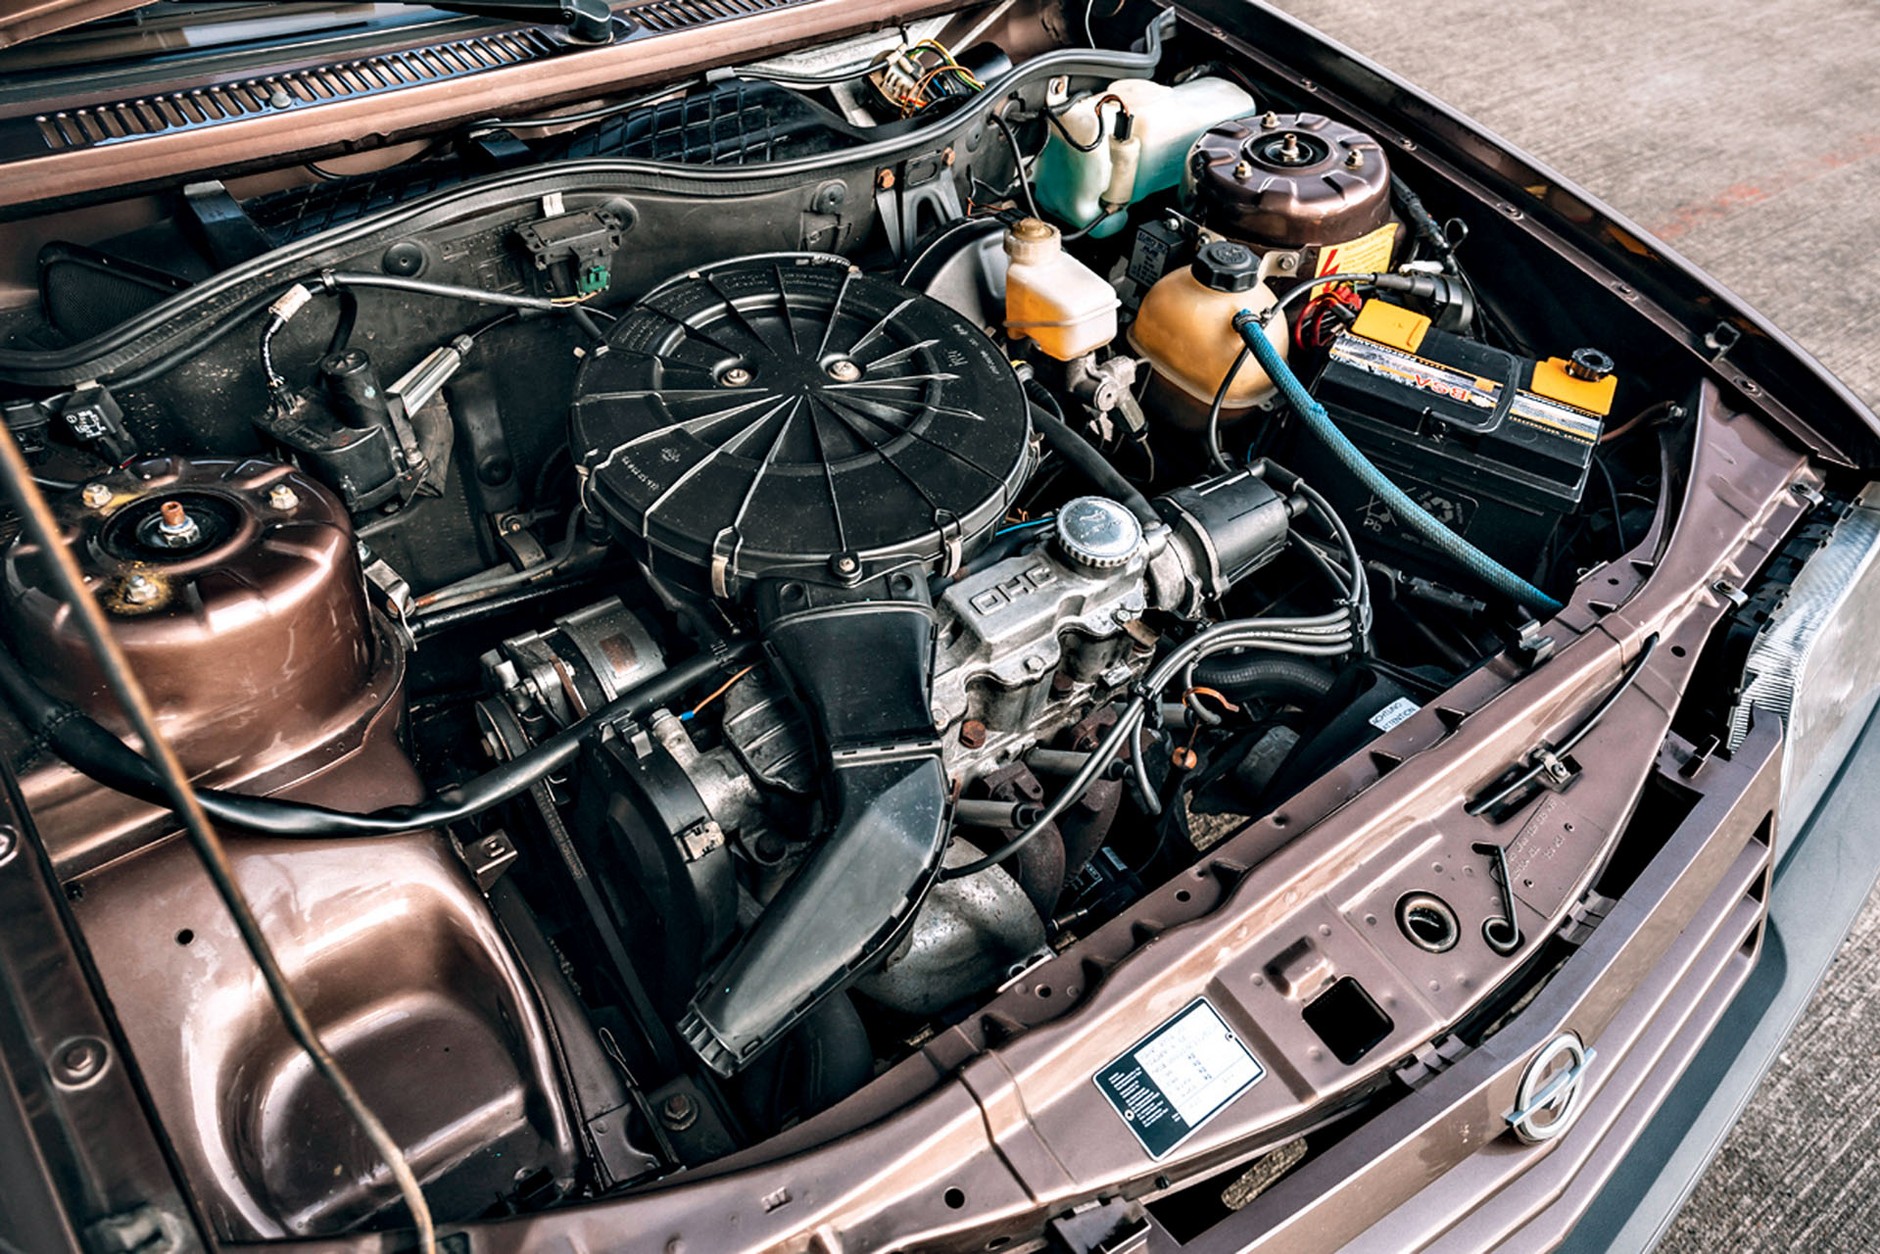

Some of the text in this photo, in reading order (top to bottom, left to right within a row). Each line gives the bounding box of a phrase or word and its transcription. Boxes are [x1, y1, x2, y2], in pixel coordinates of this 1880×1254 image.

[1415, 374, 1468, 400] BSA
[1363, 518, 1383, 533] Pb
[968, 564, 1058, 616] OHC
[1382, 706, 1416, 730] ATTENTION
